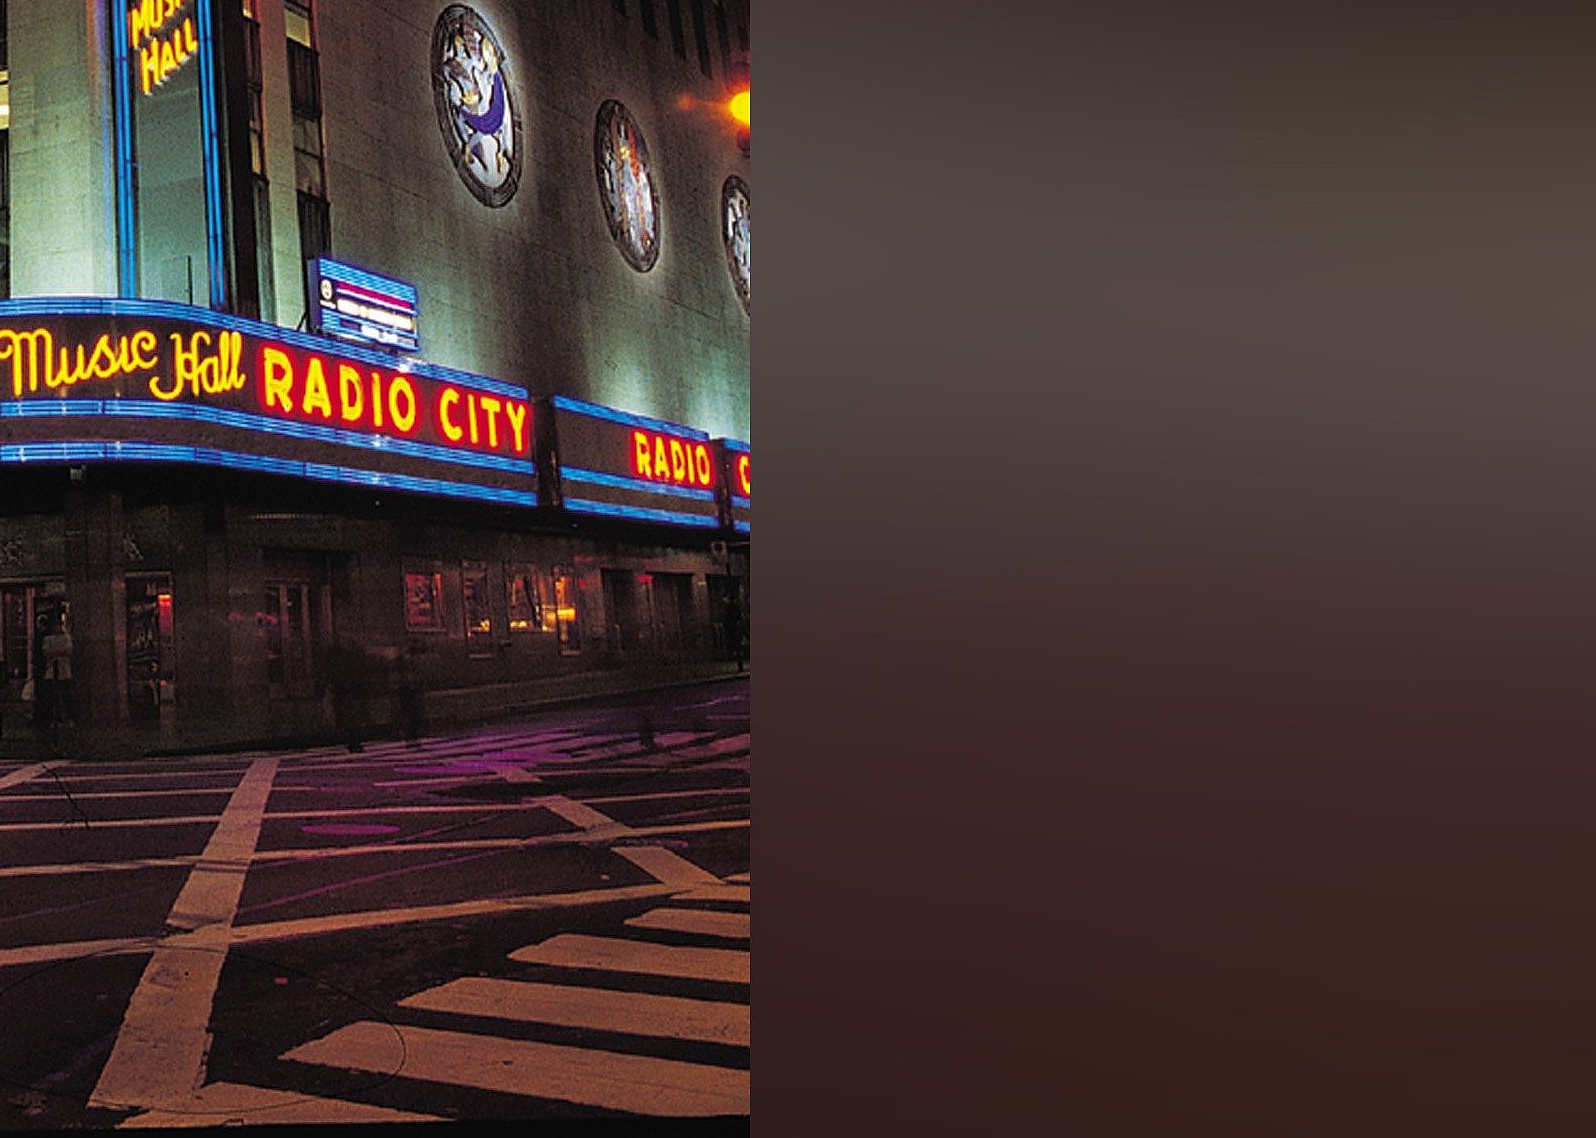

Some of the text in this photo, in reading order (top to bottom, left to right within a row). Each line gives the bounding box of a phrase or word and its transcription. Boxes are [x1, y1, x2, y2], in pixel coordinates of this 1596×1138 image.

[149, 330, 247, 400] Hall
[263, 347, 417, 432] RADIO
[439, 388, 526, 451] CITY
[634, 430, 711, 485] RADIO
